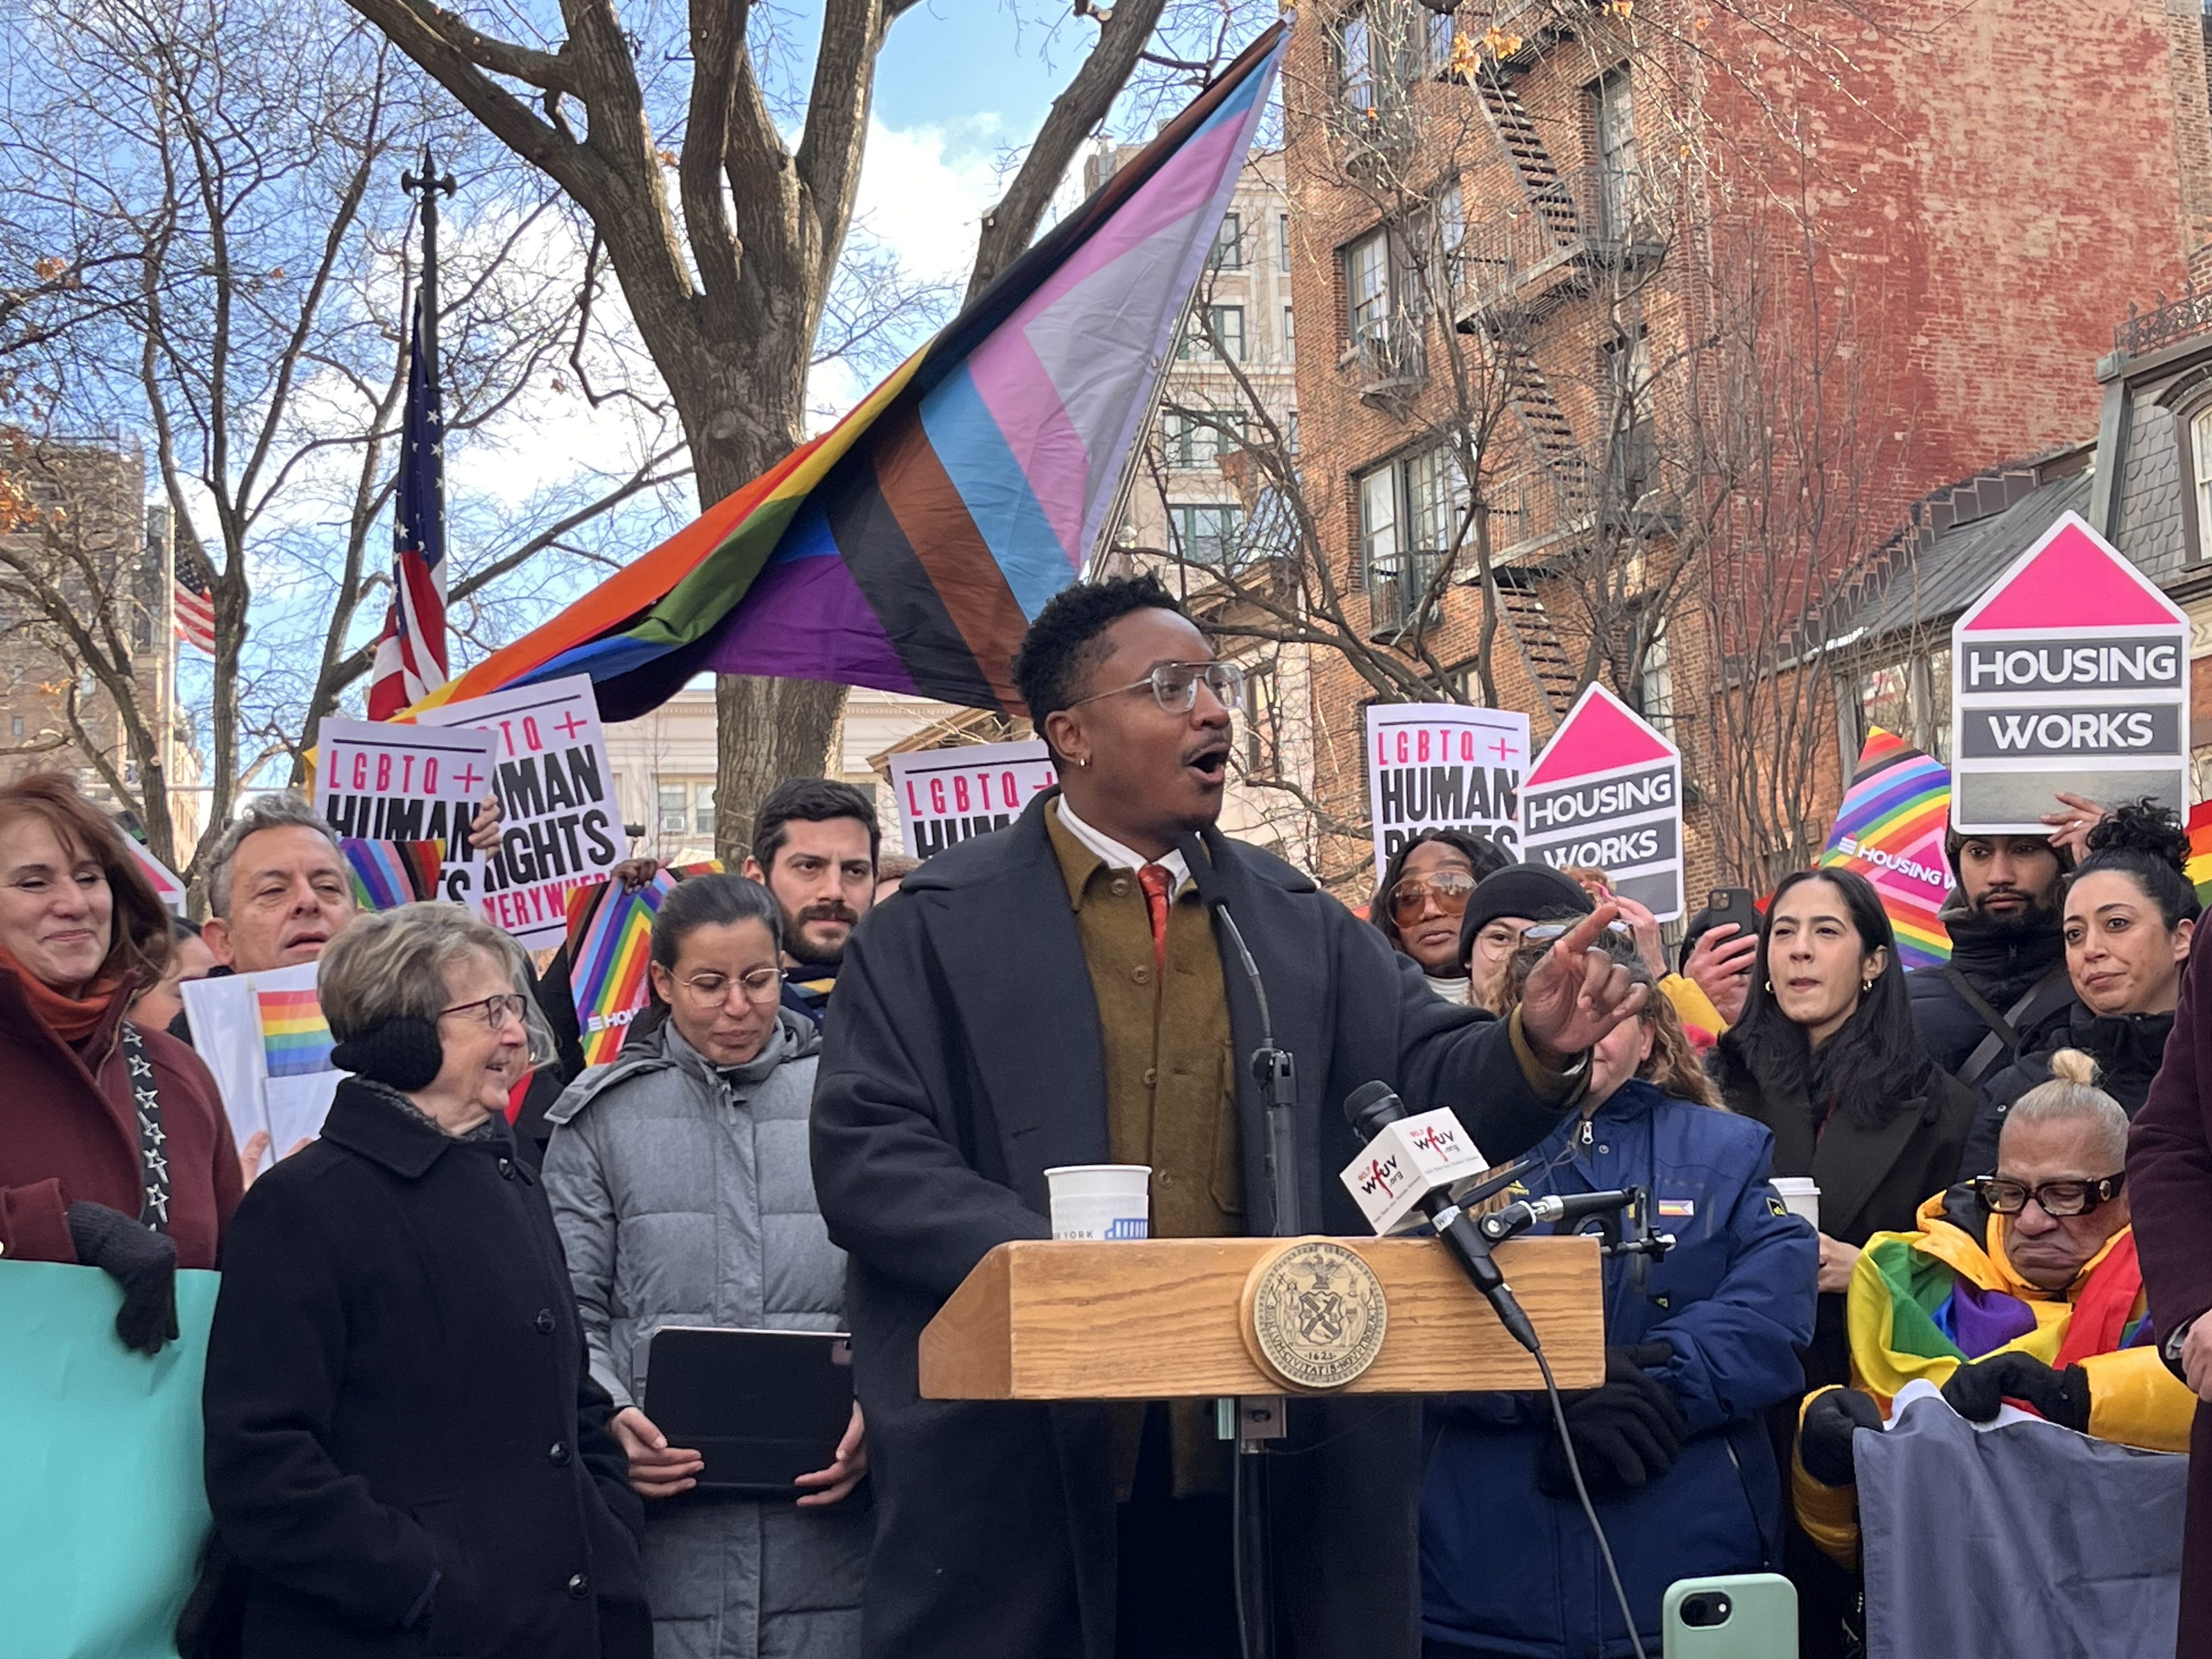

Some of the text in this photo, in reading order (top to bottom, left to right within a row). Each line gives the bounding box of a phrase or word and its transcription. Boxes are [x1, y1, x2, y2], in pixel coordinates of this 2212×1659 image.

[1970, 645, 2176, 686] HOUSING
[1988, 712, 2154, 750] WORKS
[1380, 766, 1519, 824] HUMAN
[1530, 774, 1672, 829] HOUSING
[1543, 829, 1658, 871] WORKS
[1857, 844, 1942, 886] HOUSING
